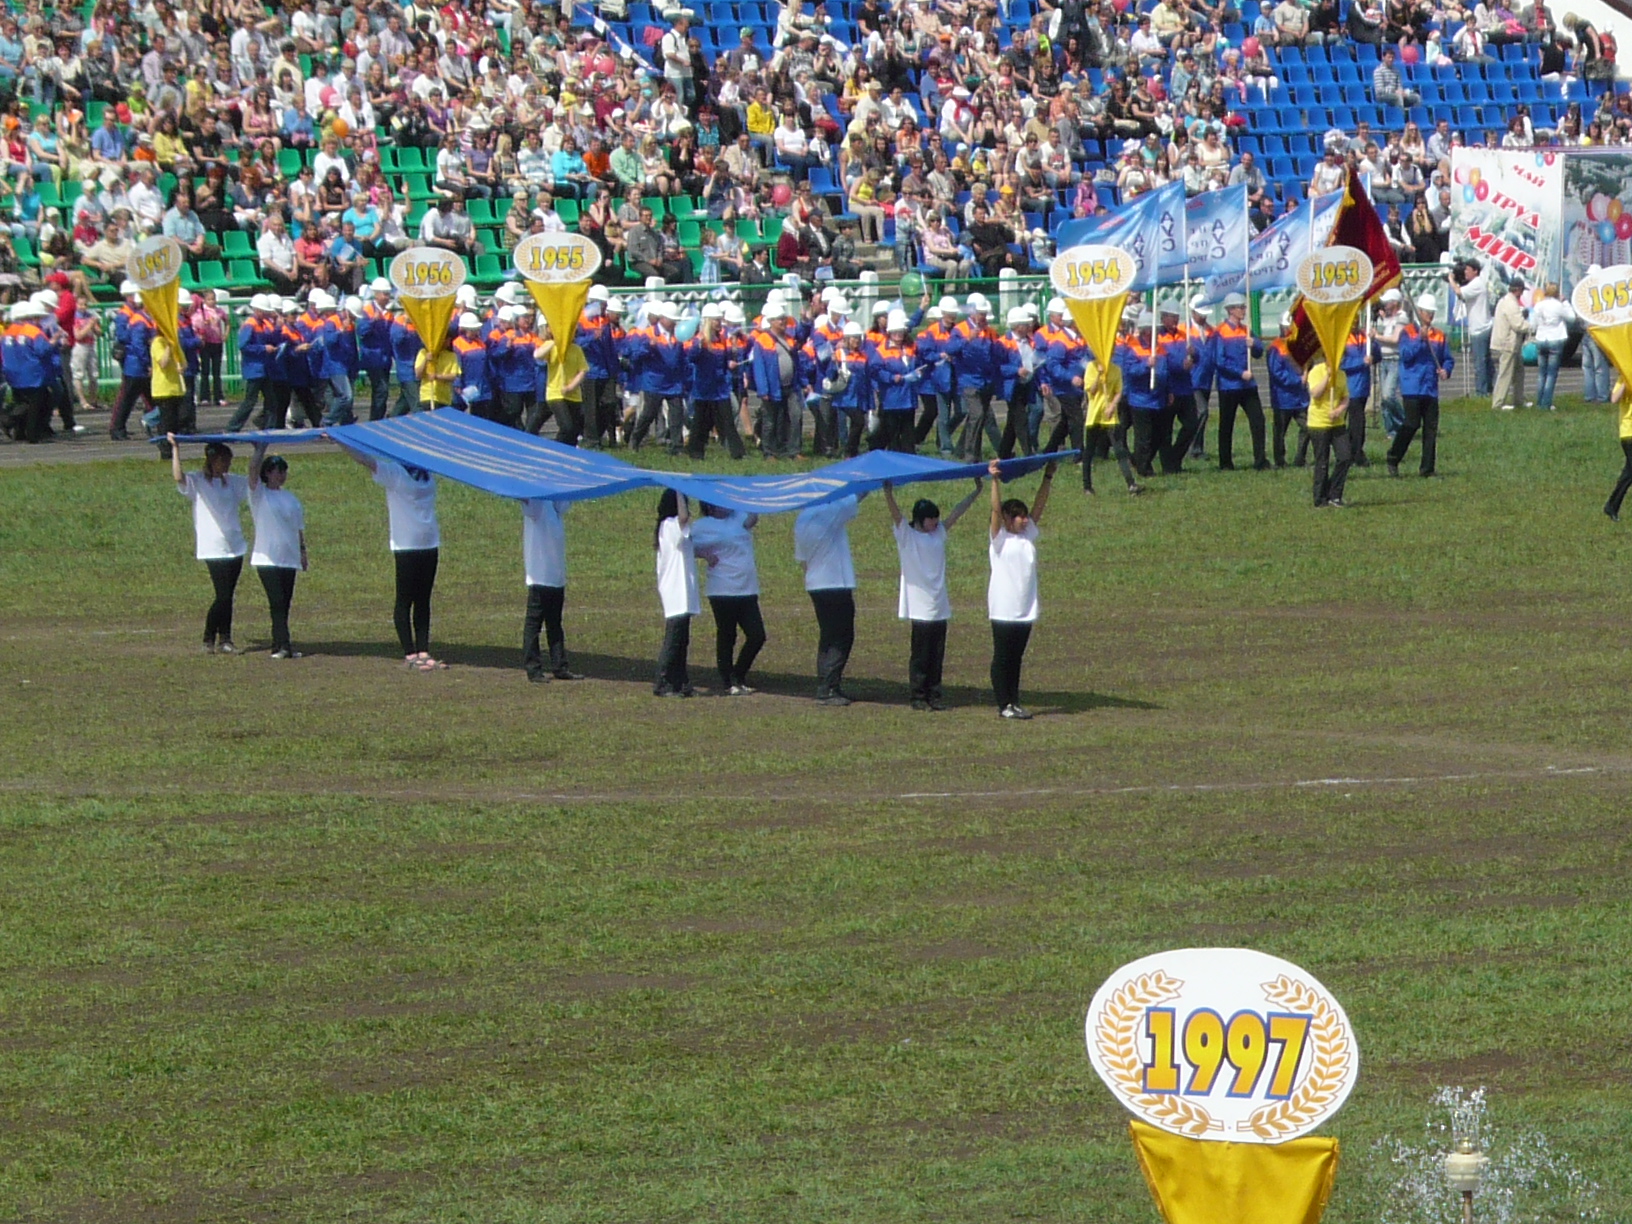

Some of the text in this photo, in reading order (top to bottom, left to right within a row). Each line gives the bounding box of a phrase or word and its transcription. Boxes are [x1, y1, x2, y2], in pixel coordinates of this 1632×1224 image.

[136, 245, 171, 279] 1957
[530, 245, 585, 271] 1955
[1463, 224, 1537, 271] МИР
[404, 261, 453, 286] 1956
[1066, 256, 1121, 288] 1954
[1312, 259, 1360, 289] 1953
[1142, 1006, 1314, 1101] 1997
